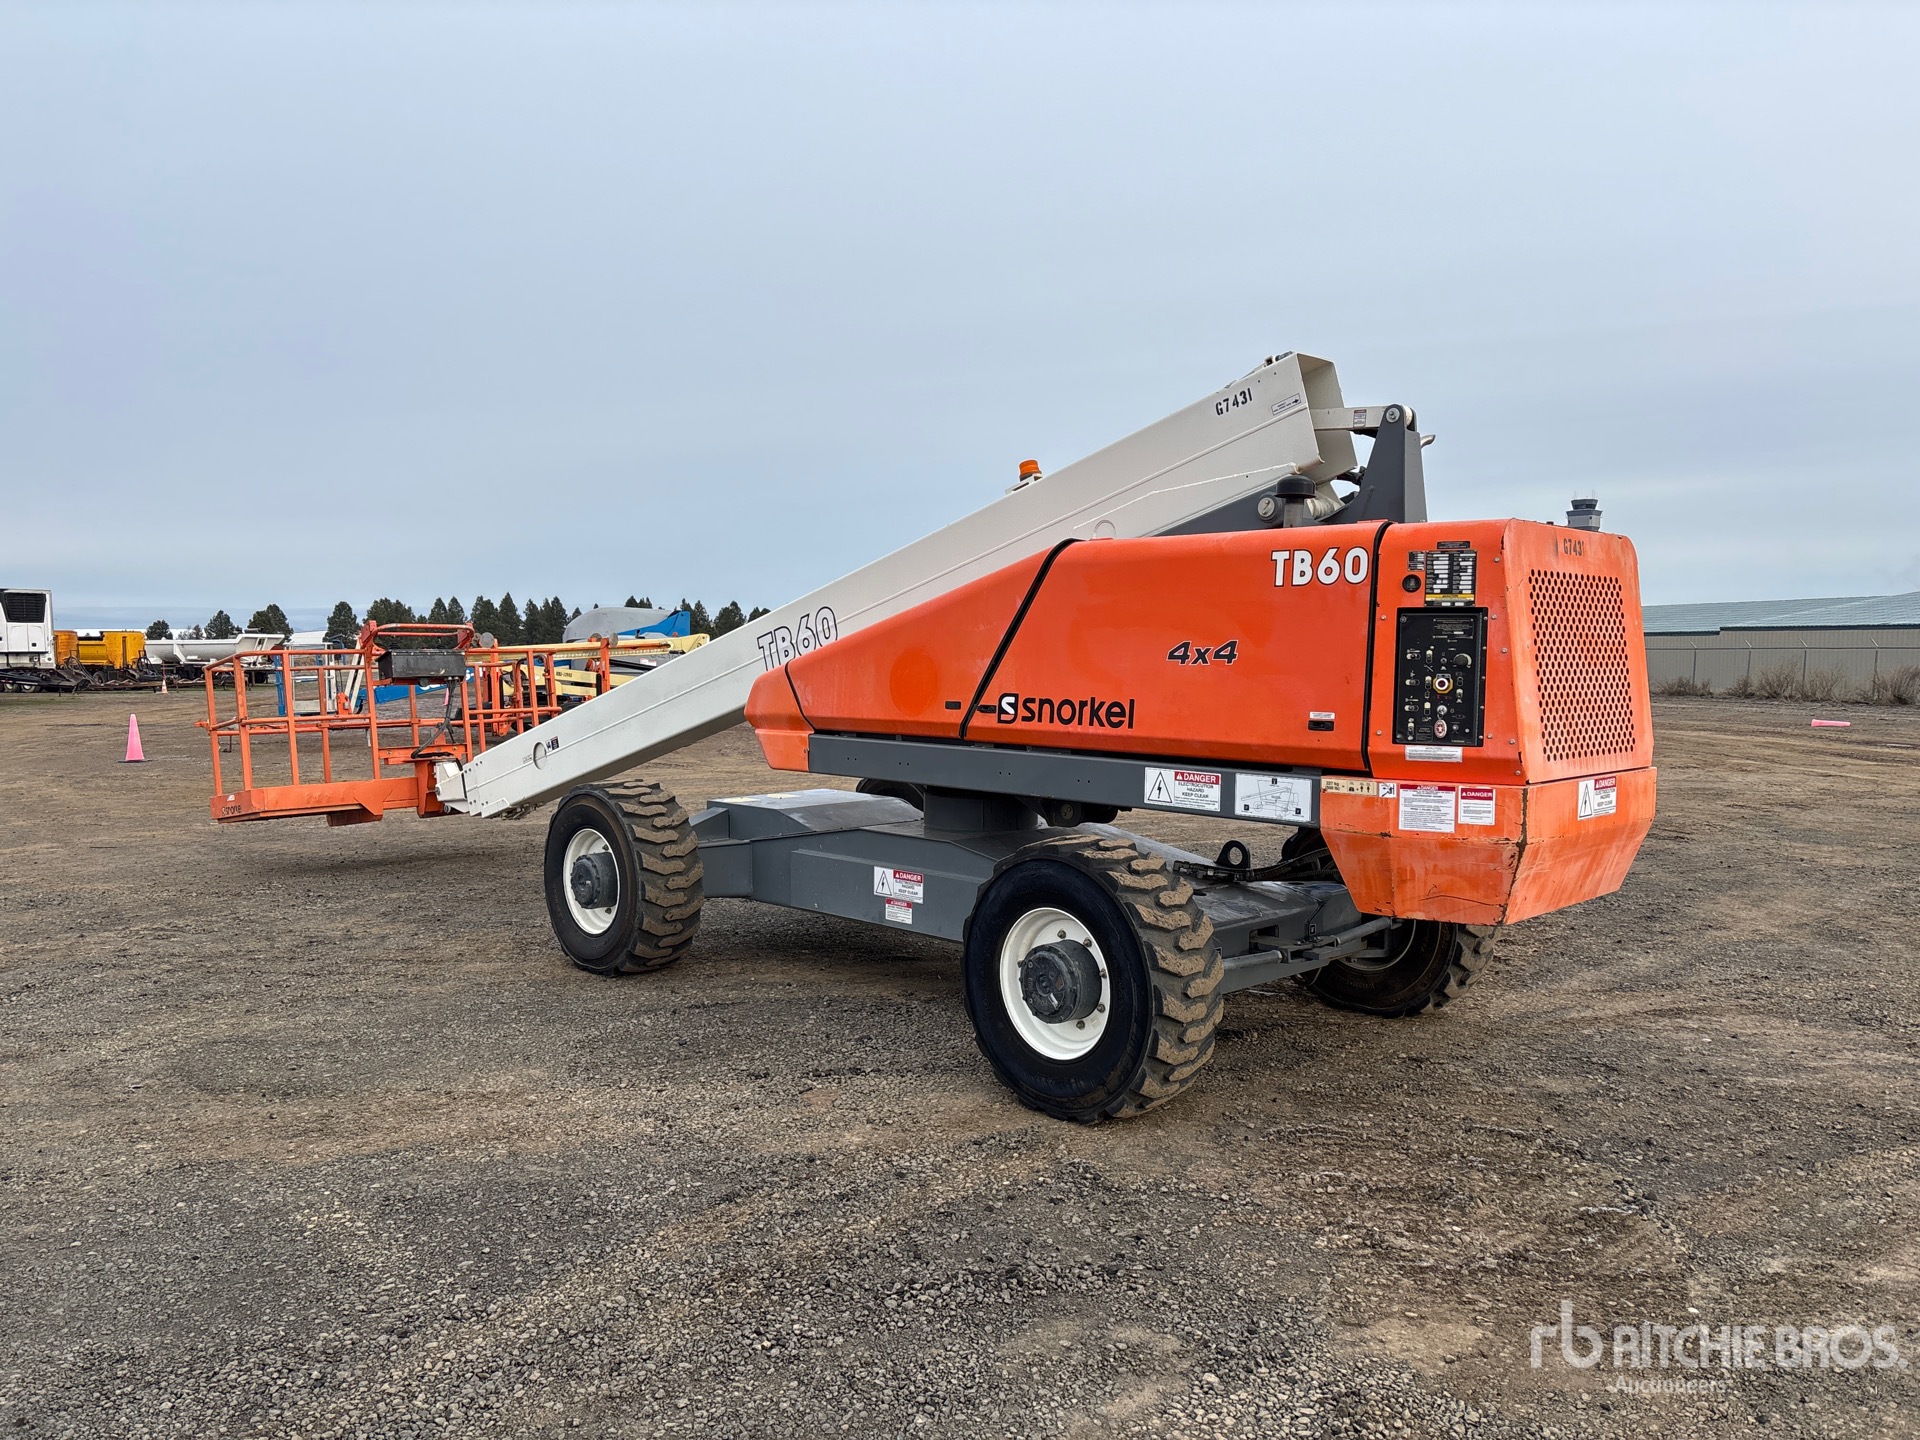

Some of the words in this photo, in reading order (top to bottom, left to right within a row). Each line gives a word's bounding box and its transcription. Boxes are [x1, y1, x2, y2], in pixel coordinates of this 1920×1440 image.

[1215, 388, 1253, 416] G7431
[1270, 546, 1370, 588] TB60
[757, 606, 838, 671] TB60
[1167, 639, 1239, 666] 4x4
[1021, 696, 1135, 730] snorkel
[1183, 773, 1217, 784] DANGER
[899, 872, 922, 882] DANGER
